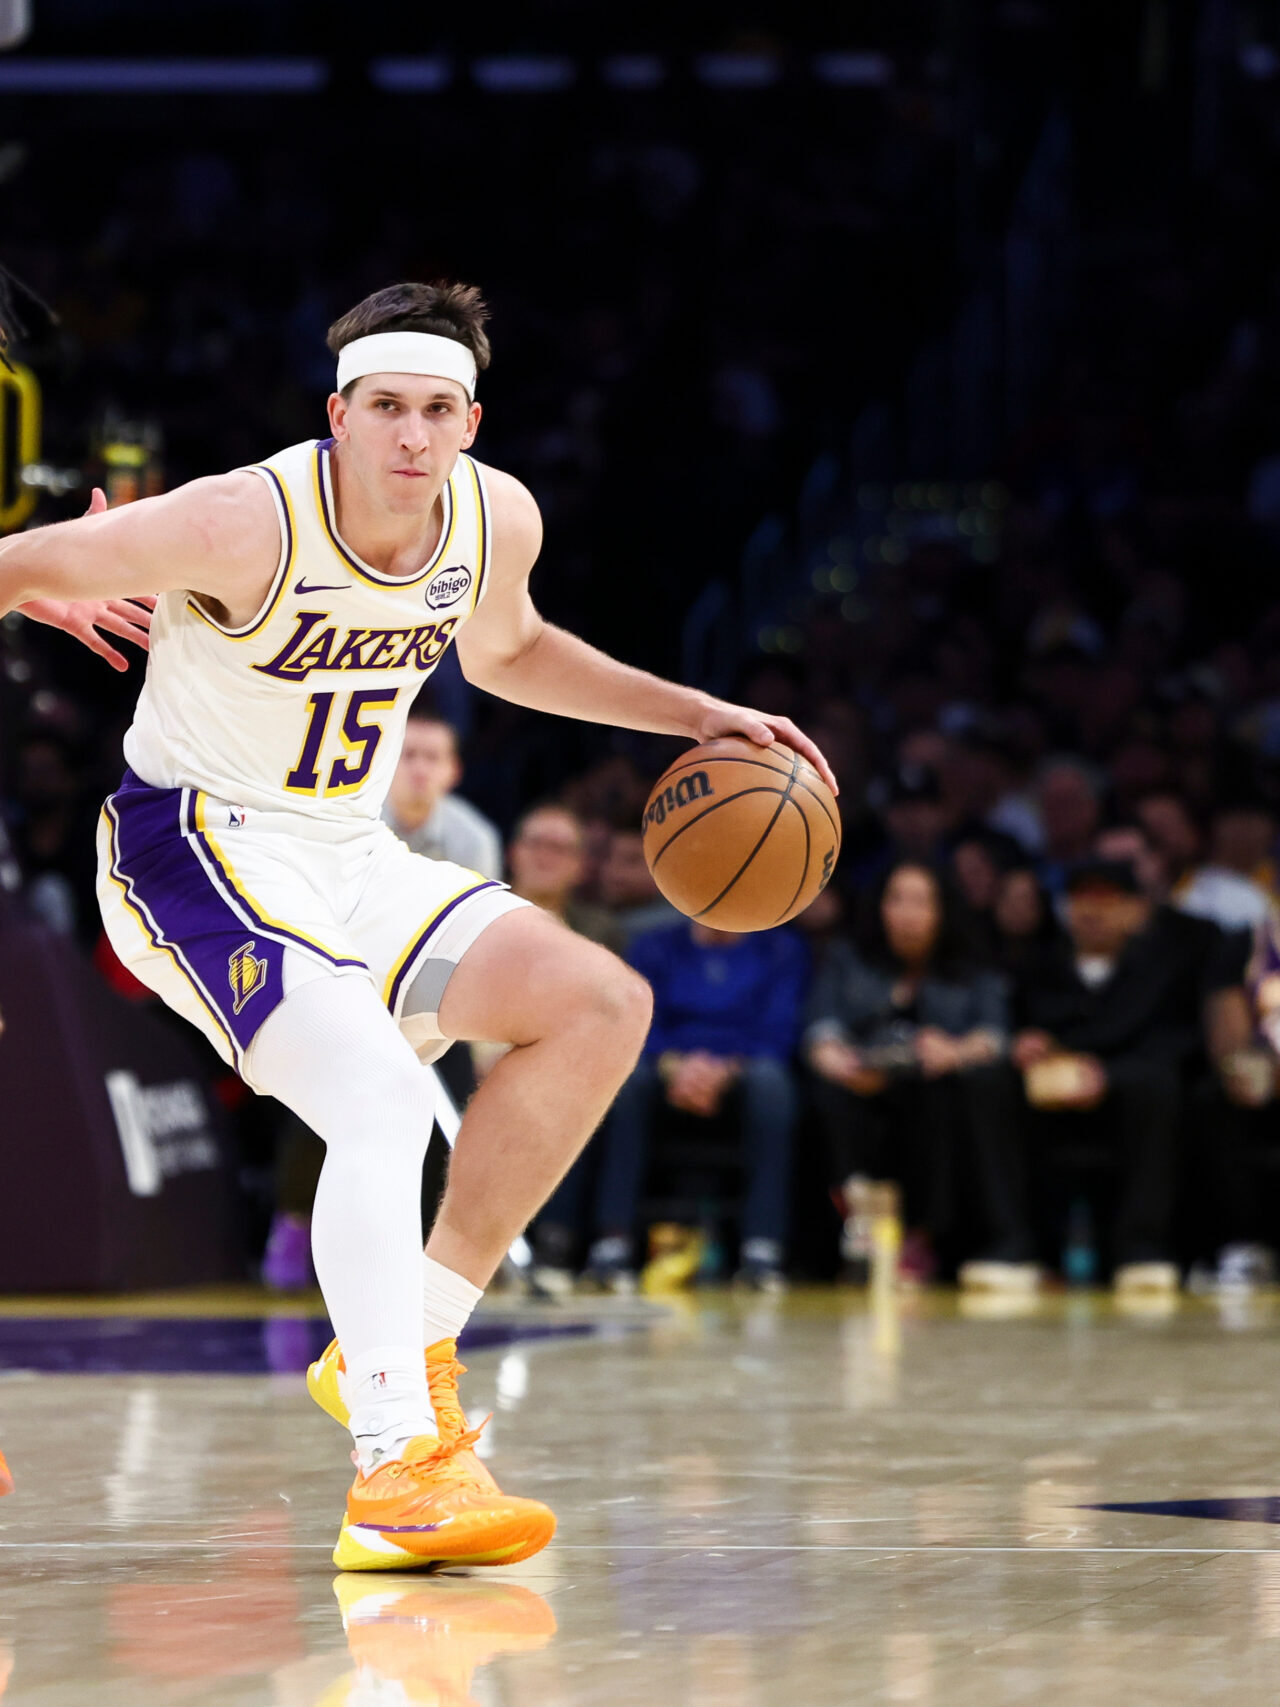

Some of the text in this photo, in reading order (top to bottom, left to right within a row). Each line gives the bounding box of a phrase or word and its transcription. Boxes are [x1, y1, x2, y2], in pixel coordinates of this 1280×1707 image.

[429, 577, 469, 596] bibigo
[248, 609, 462, 683] LAKERS
[283, 687, 400, 798] 15
[641, 770, 716, 838] Wilso
